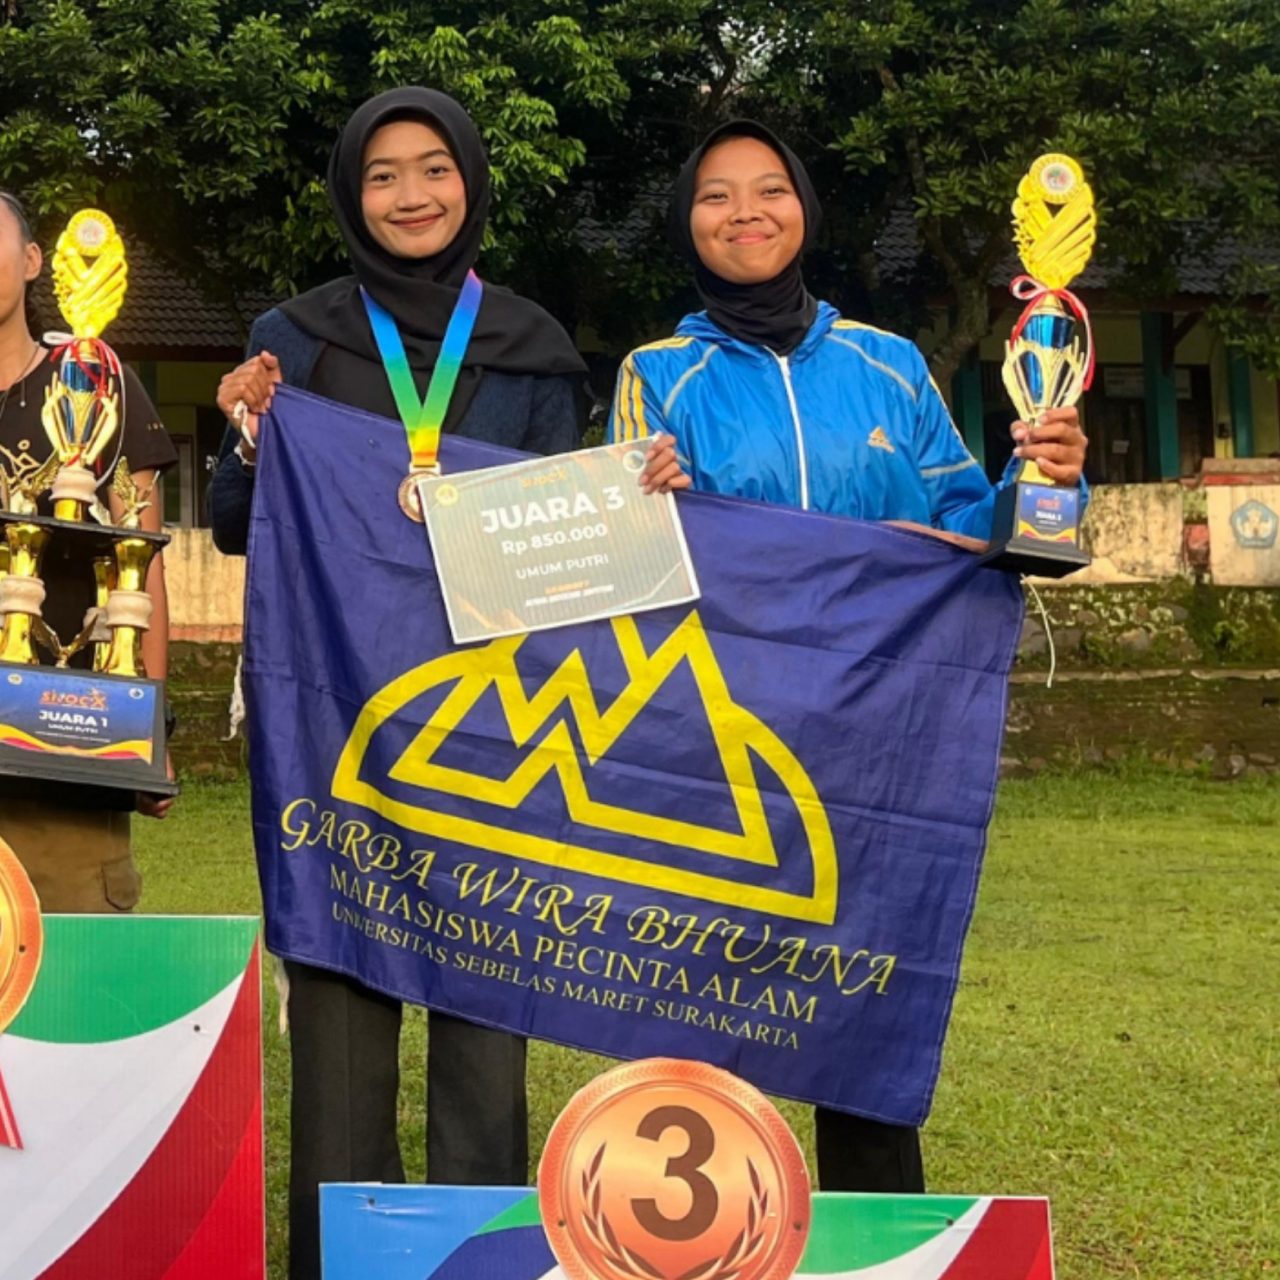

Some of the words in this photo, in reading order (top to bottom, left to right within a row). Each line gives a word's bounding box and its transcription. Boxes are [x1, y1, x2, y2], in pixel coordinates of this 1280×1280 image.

[481, 492, 598, 534] JUARA
[603, 486, 625, 510] 3
[501, 539, 528, 556] Rp
[531, 523, 608, 550] 850.000
[516, 562, 563, 579] UMUM
[566, 554, 609, 571] PUTRI
[39, 710, 97, 726] JUARA
[101, 717, 108, 727] 1
[280, 798, 438, 890] GARBA
[452, 862, 615, 935] WIRA
[626, 906, 897, 996] BHUANA
[329, 864, 523, 957] MAHASISWA
[533, 936, 690, 993] PECINTA
[700, 976, 817, 1023] ALAM
[332, 908, 449, 965] UNIVERSITAS
[452, 949, 556, 994] SEBELAS
[562, 978, 649, 1013] MARET
[653, 999, 800, 1049] SURAKARTA
[630, 1105, 719, 1242] 3
